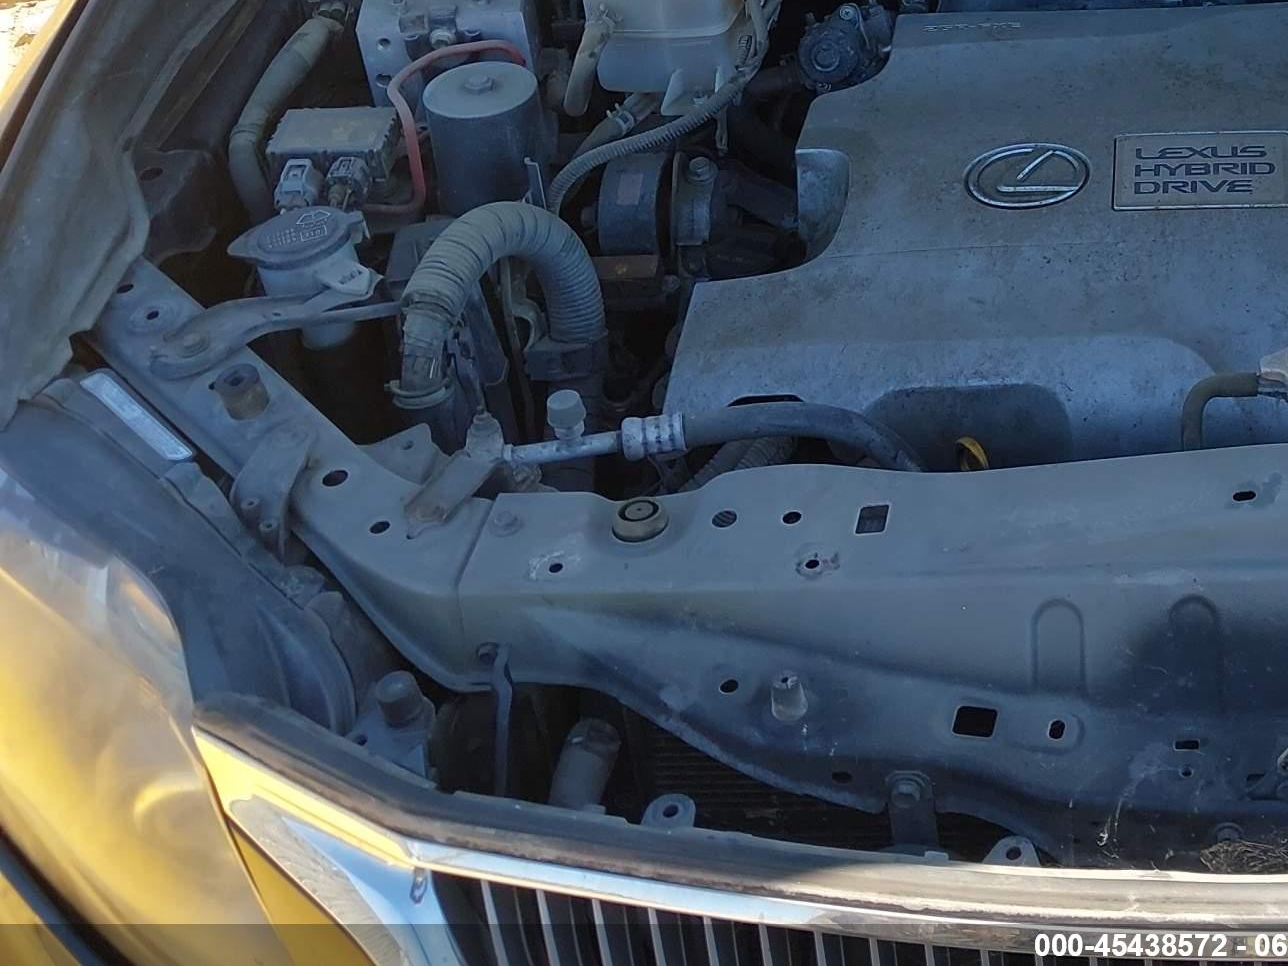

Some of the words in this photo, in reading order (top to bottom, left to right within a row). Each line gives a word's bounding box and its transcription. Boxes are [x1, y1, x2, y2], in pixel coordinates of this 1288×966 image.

[1135, 146, 1267, 160] LEXUS
[1134, 162, 1275, 177] HYBRID
[1133, 180, 1253, 194] DRIVE
